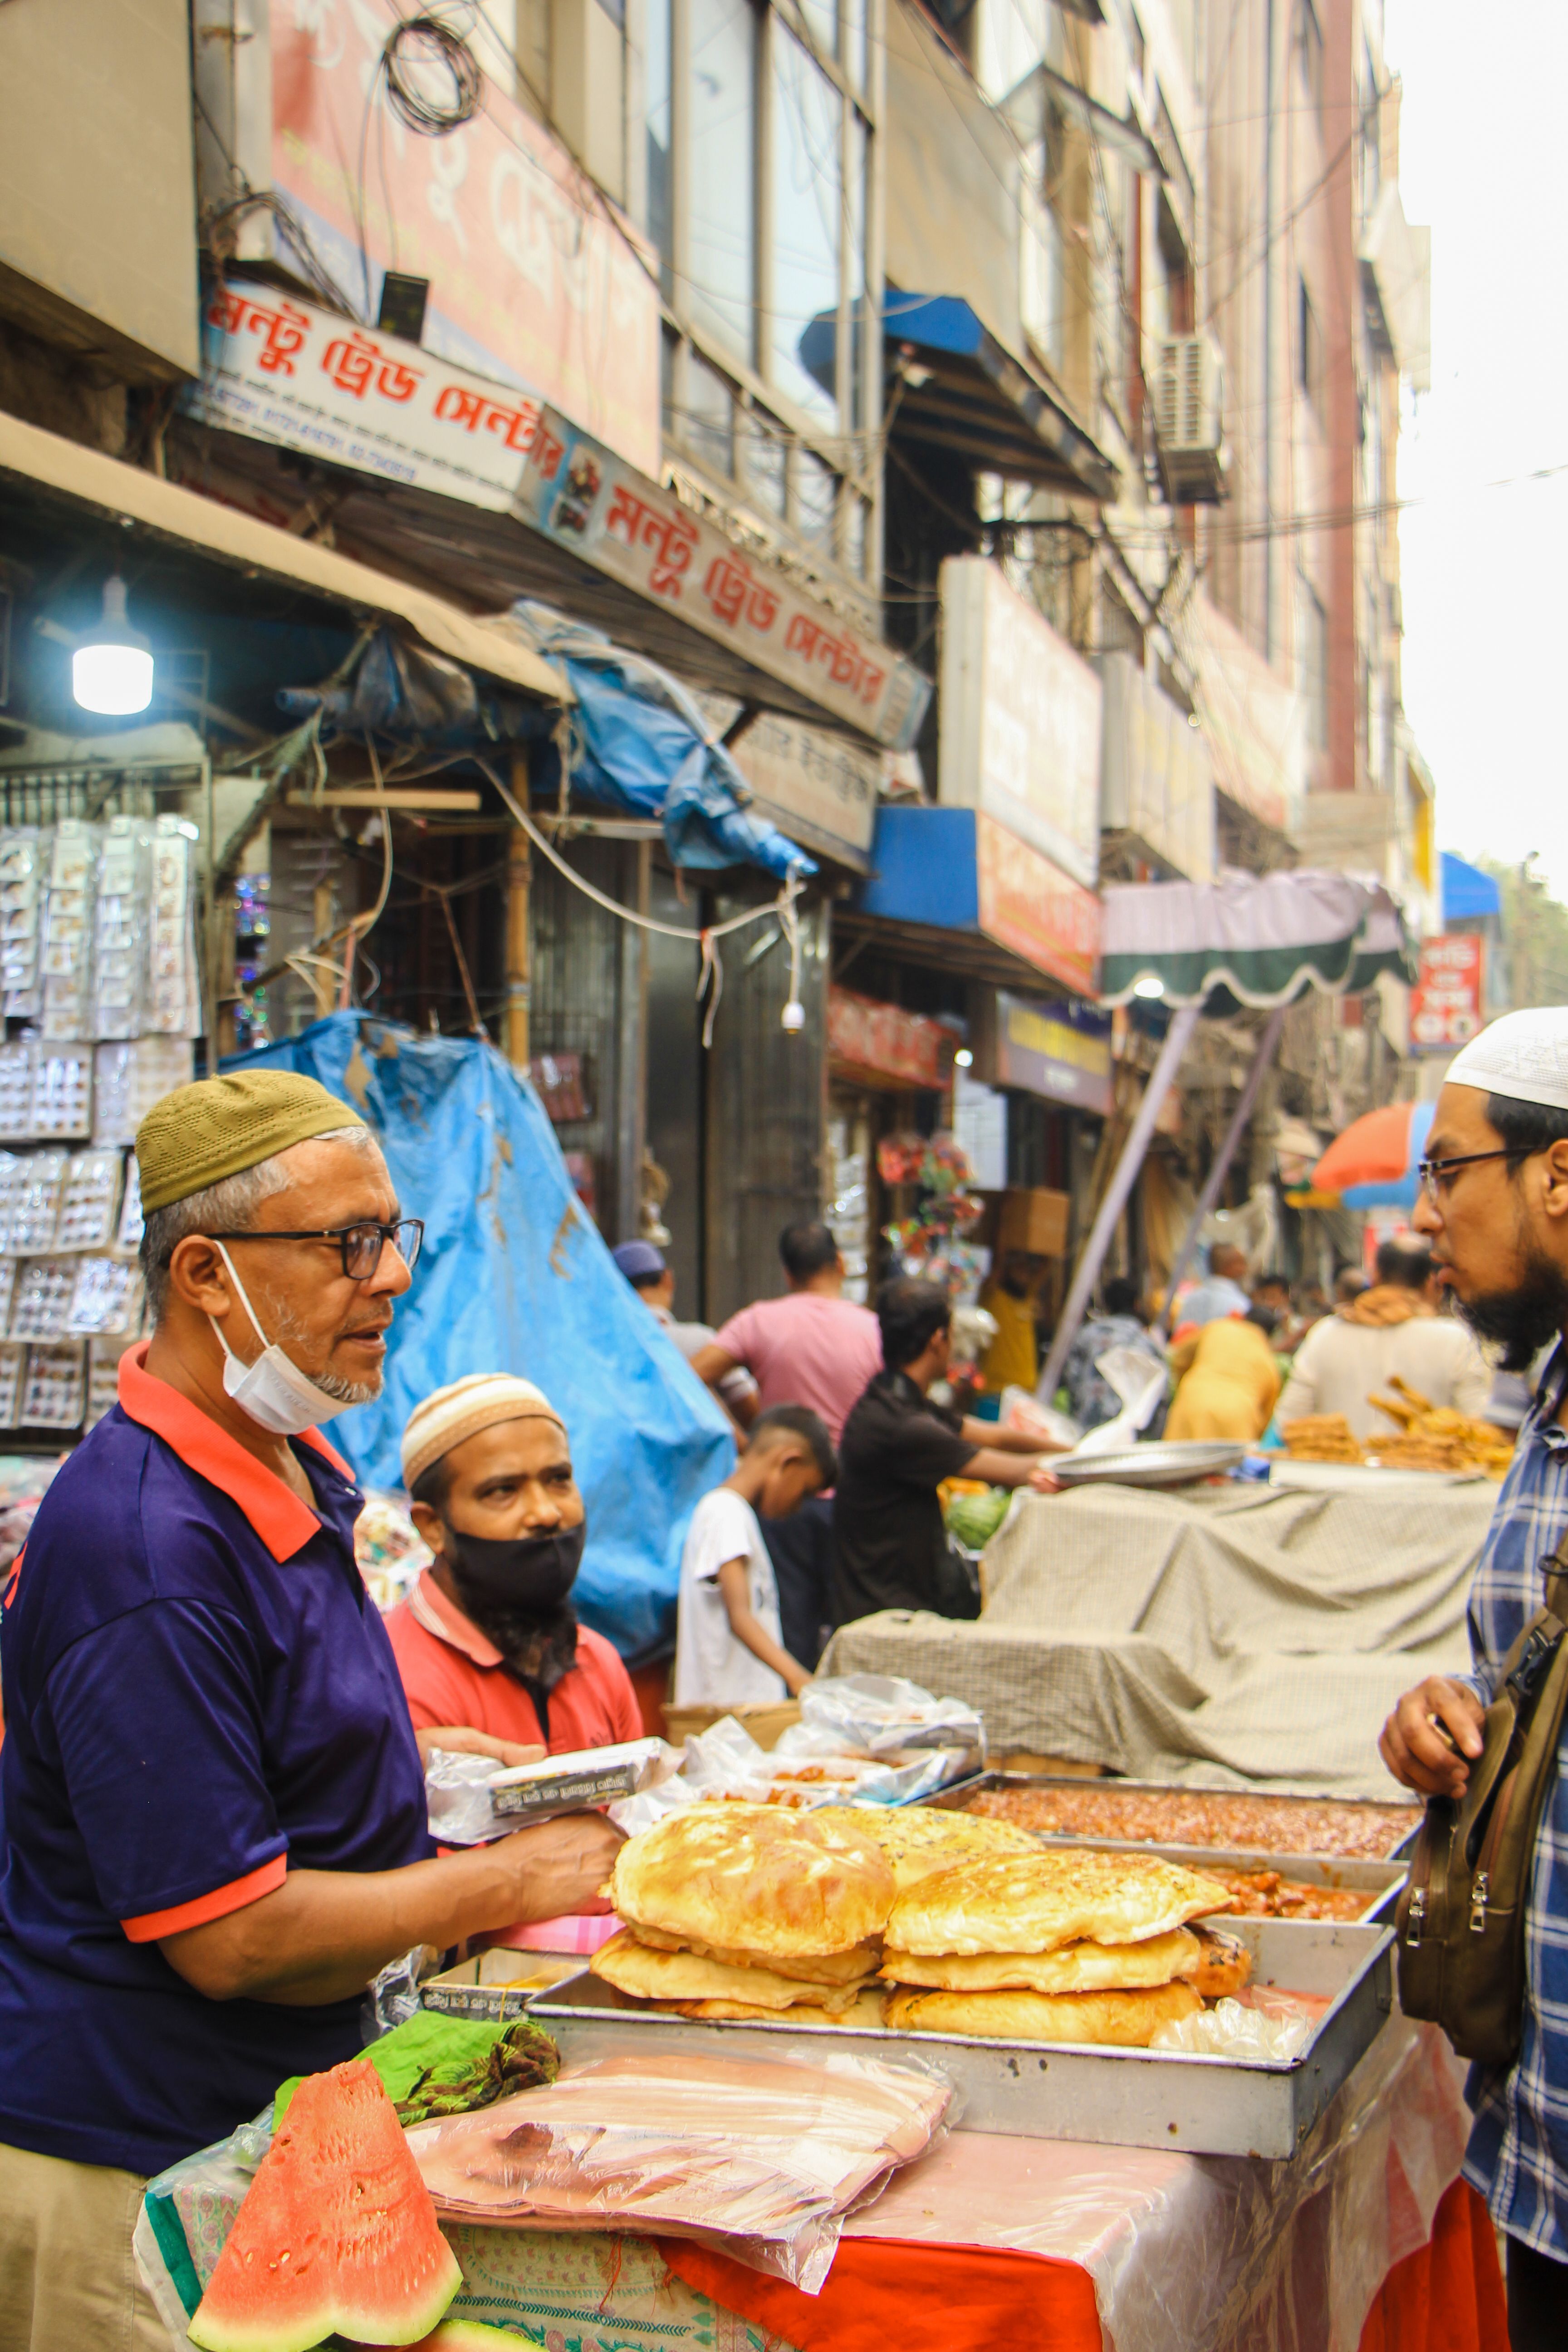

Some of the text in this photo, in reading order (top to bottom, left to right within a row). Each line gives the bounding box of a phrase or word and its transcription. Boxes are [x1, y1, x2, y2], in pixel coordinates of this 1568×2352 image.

[321, 331, 425, 401] ট্রেড
[432, 387, 565, 480] সেন্টার
[606, 485, 699, 601] মন্টু
[703, 548, 782, 632] ট্রেড
[784, 615, 885, 705] সেন্টার
